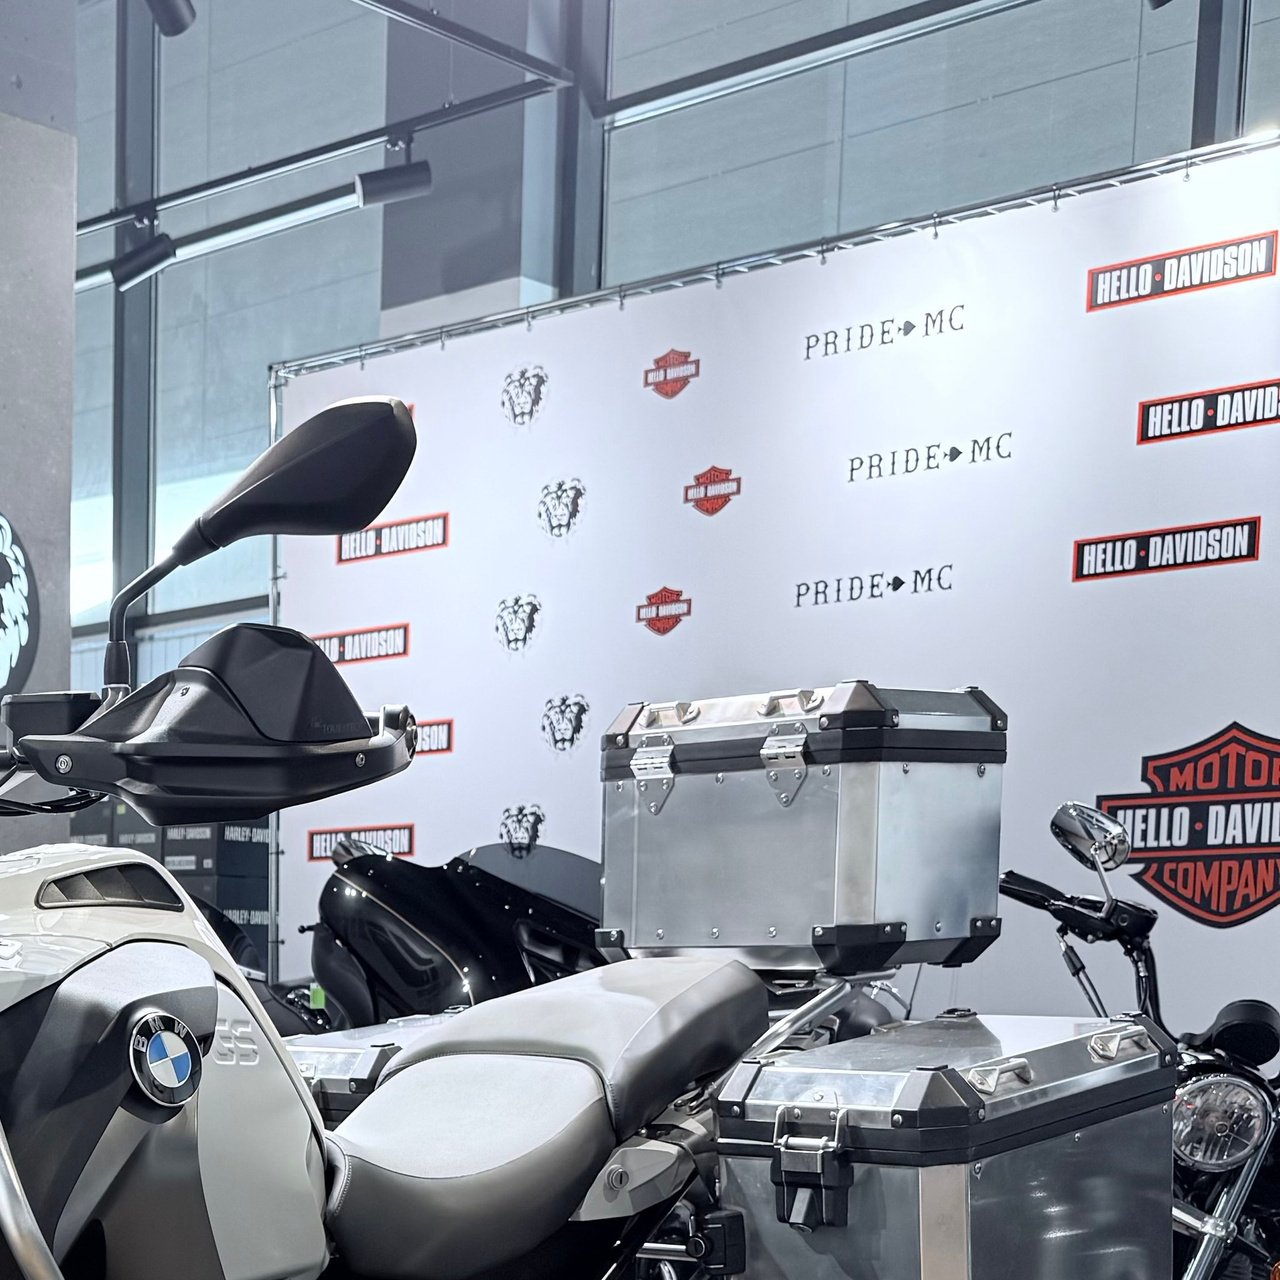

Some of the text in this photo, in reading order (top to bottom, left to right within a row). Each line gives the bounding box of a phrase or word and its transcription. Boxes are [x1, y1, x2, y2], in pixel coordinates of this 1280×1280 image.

[1096, 239, 1267, 305] HELLO DAVIDSON
[803, 304, 965, 361] PRIDE MC
[1147, 386, 1280, 437] HELLO DAVID
[848, 432, 1013, 483] PRIDE MC
[341, 517, 445, 560] HELLO DAVIDSON
[1082, 525, 1249, 575] HELLO DAVIDSON
[794, 564, 953, 608] PRIDE MC
[344, 627, 405, 660] DAVIDSON
[134, 1017, 187, 1052] BMW
